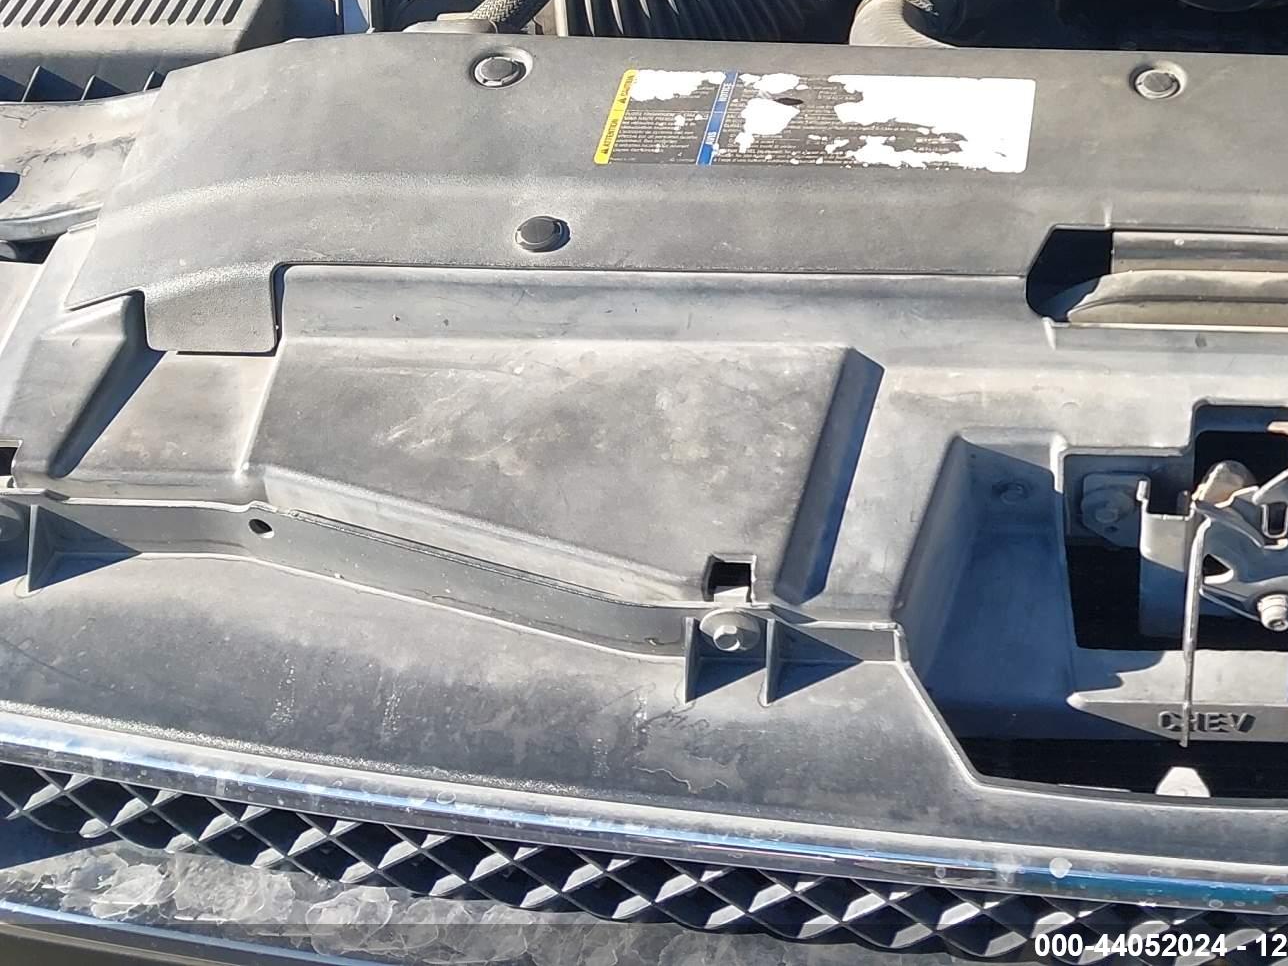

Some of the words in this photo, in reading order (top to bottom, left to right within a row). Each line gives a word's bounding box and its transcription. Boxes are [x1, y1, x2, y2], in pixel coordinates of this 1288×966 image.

[717, 82, 732, 102] NOTICE
[602, 118, 618, 147] ATTENTION
[704, 131, 717, 145] AVIS
